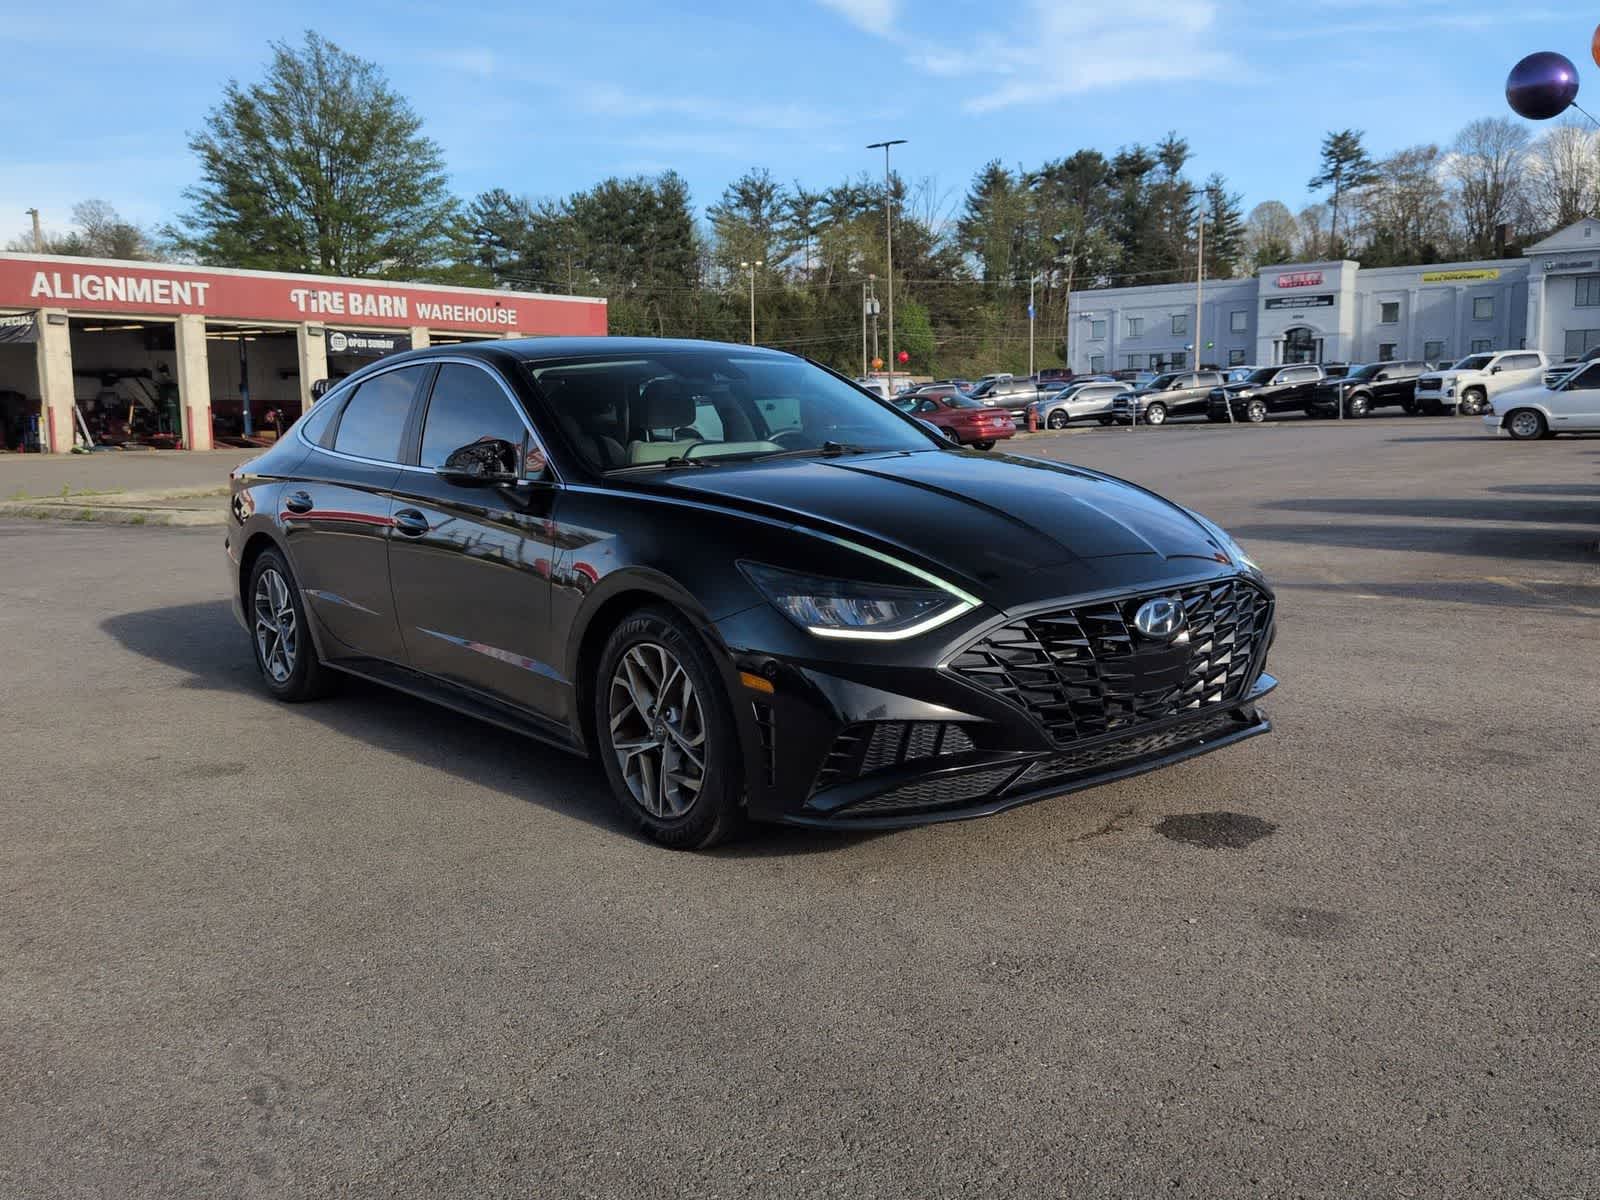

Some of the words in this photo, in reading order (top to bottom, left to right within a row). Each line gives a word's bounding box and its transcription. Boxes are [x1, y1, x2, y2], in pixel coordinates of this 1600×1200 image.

[31, 271, 210, 307] ALIGNMENT
[0, 315, 33, 328] PECIAL
[349, 292, 408, 318] BARN
[416, 302, 517, 325] WAREHOUSE
